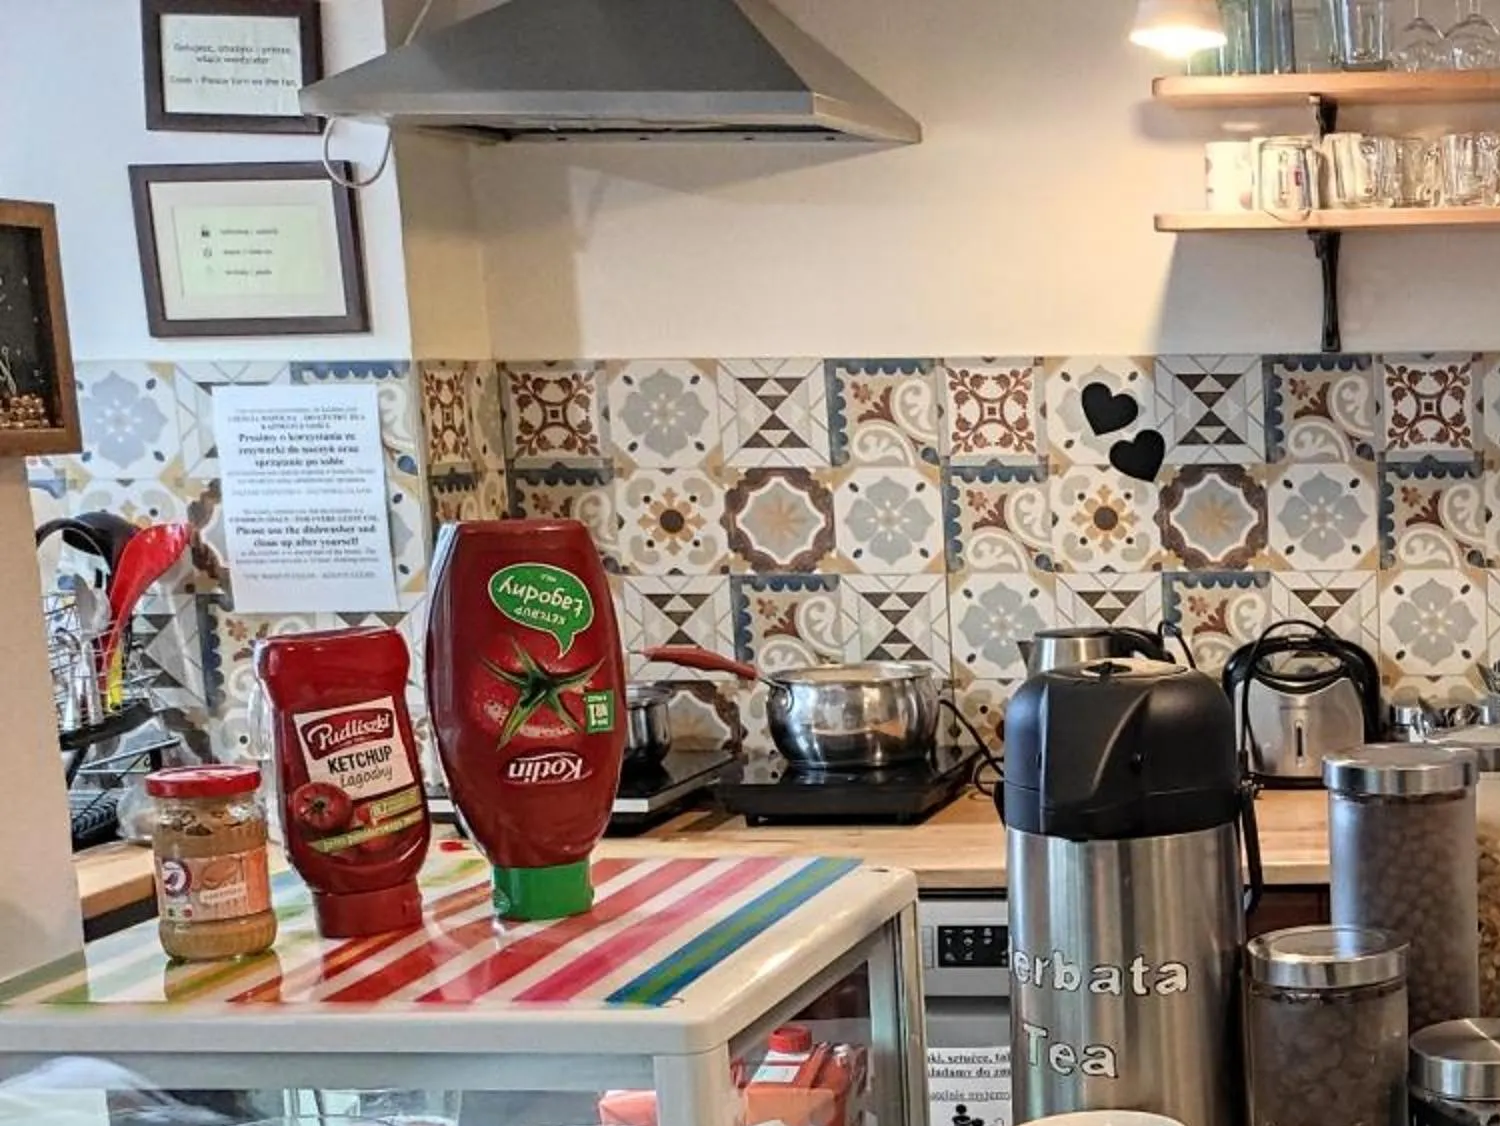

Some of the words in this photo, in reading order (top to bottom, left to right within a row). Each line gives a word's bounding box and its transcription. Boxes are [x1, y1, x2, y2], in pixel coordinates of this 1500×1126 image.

[497, 574, 584, 615] Łagodny
[513, 606, 566, 626] KETCHUP
[308, 713, 391, 750] Pudliszki
[327, 745, 393, 775] KETCHUP
[508, 757, 584, 784] Kotlin
[1007, 936, 1190, 997] erbata
[1022, 1022, 1120, 1080] Tea
